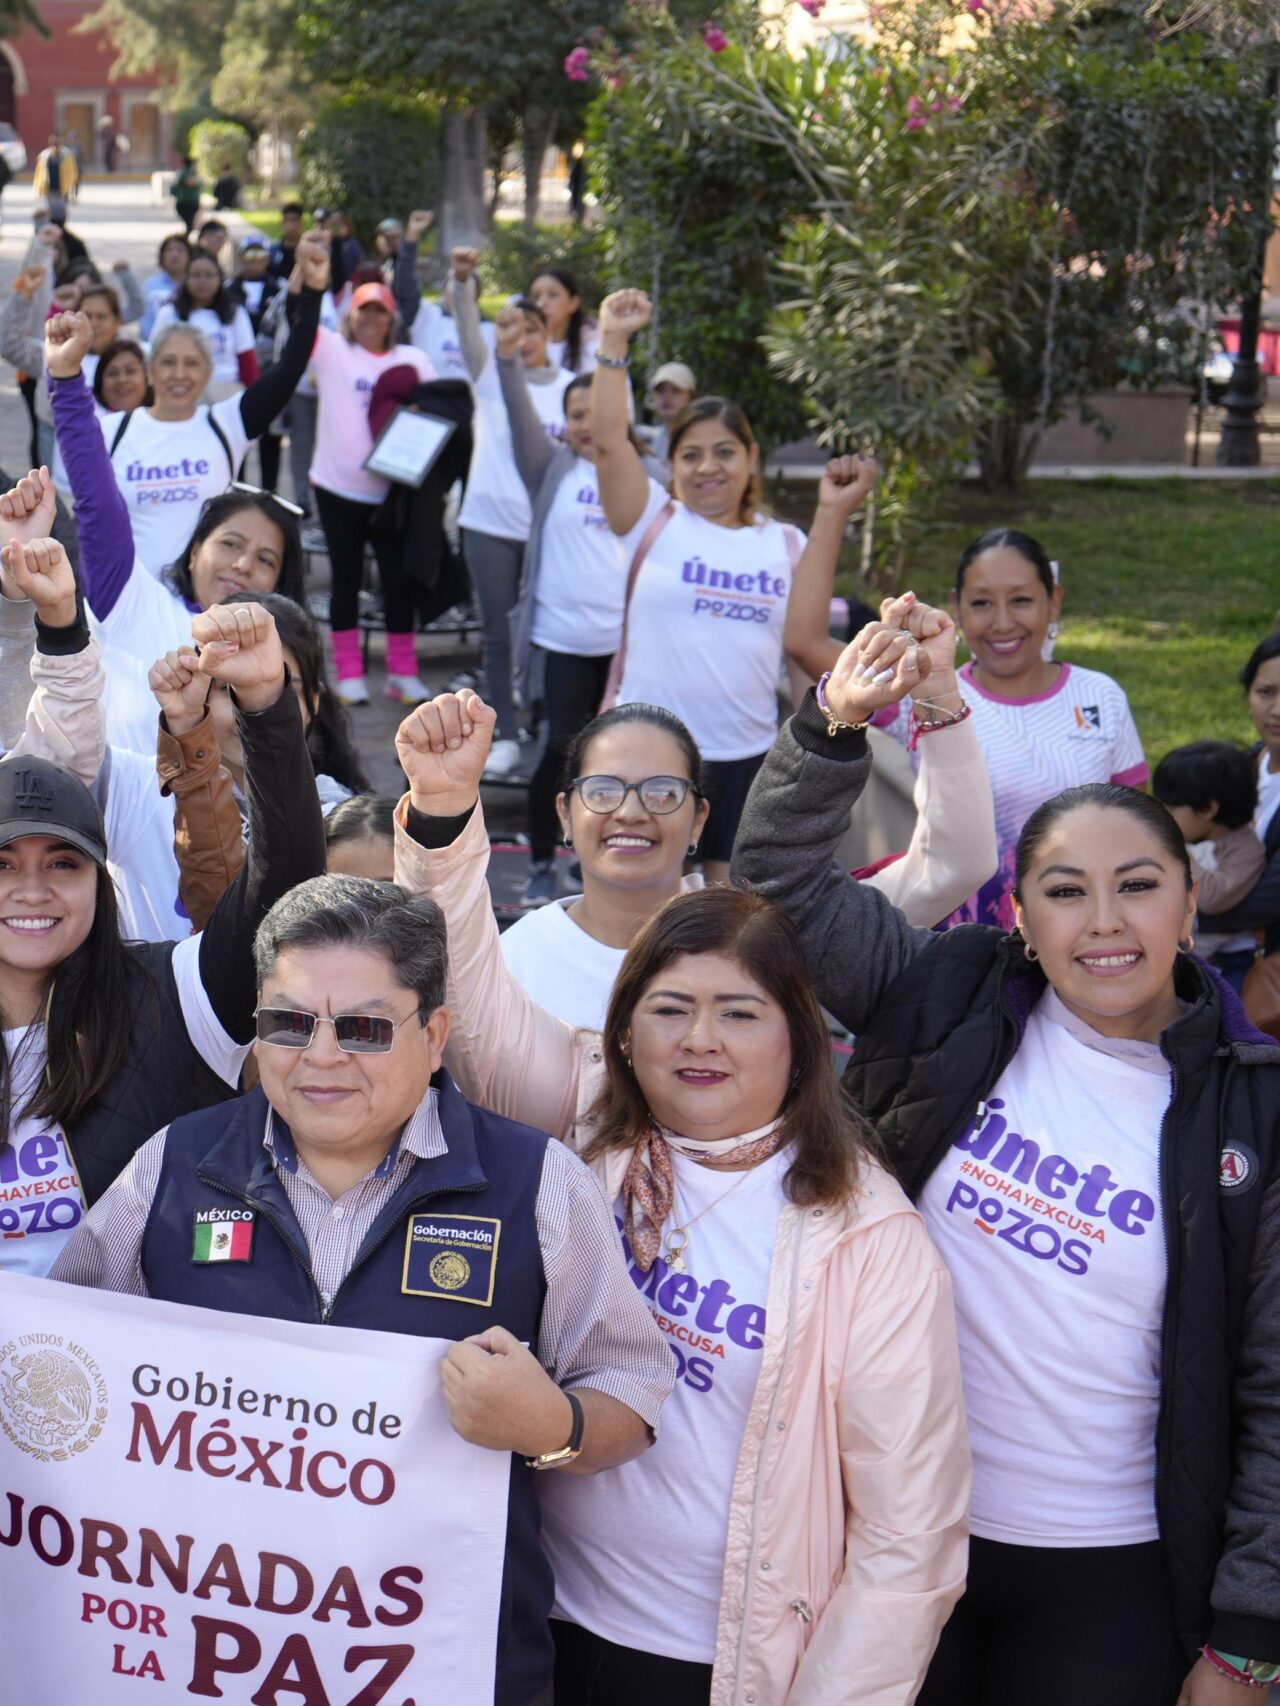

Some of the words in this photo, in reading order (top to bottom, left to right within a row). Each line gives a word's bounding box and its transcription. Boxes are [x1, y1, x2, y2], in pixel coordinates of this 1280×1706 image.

[196, 1207, 253, 1224] MÉXICO
[413, 1224, 493, 1243] Gobernación
[960, 1160, 1106, 1244] #NOHAYEXCUSA
[412, 1234, 445, 1245] Secretaría
[445, 1237, 453, 1245] de
[453, 1239, 493, 1251] Gobernación
[18, 1333, 64, 1348] UNIDOS
[66, 1340, 109, 1404] MEXICANOS
[132, 1363, 338, 1427] Gobierno
[351, 1400, 402, 1439] de
[124, 1400, 396, 1506] México
[81, 1592, 168, 1638] POR
[112, 1643, 166, 1682] LA
[186, 1614, 417, 1706] PAZ
